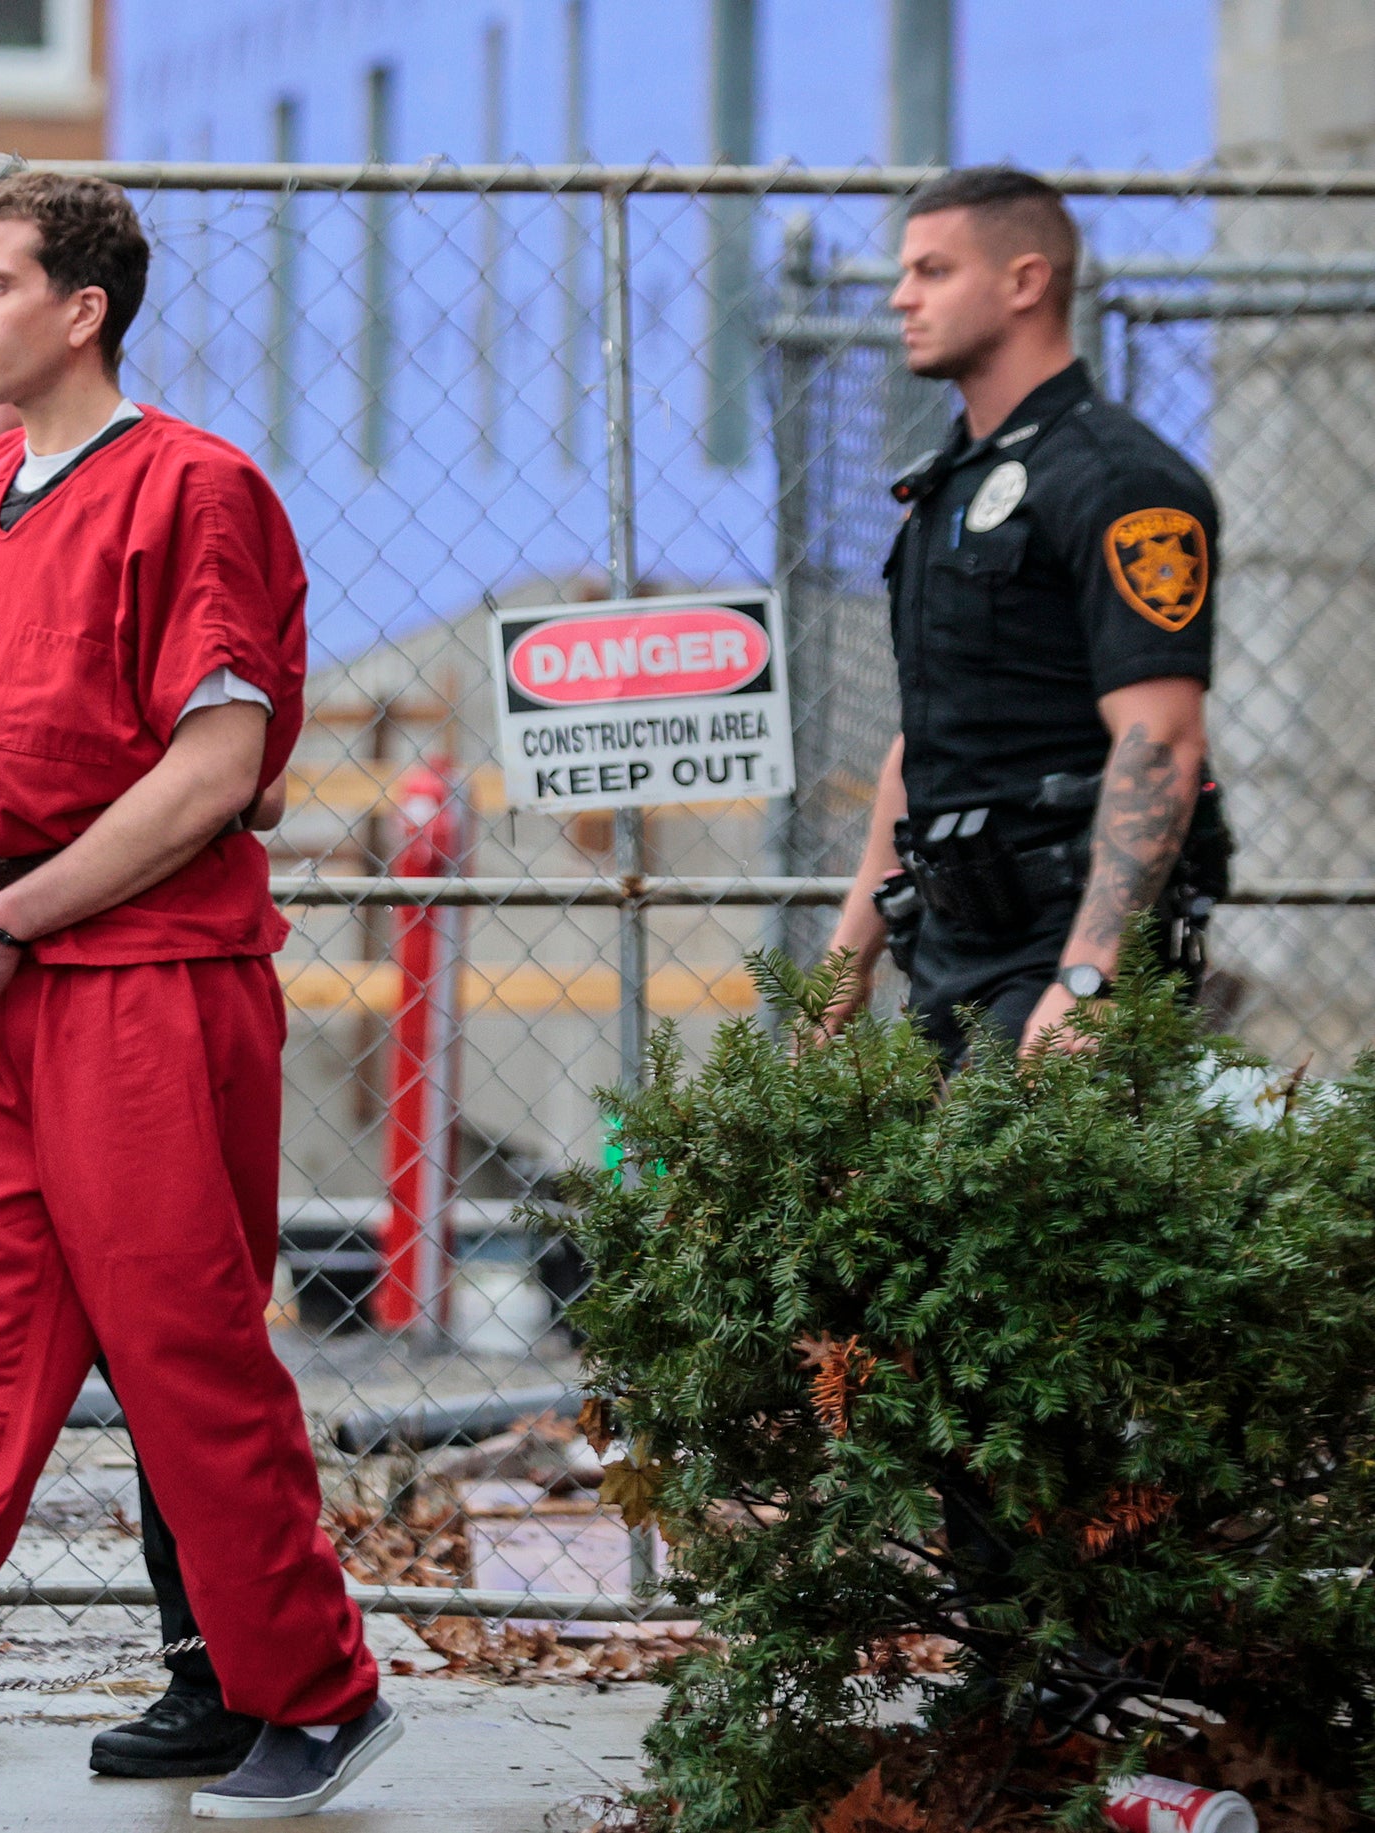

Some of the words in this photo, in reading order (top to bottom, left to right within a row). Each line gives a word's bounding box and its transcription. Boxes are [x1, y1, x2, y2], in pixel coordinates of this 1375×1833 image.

[529, 630, 748, 684] DANGER
[523, 714, 700, 757] CONSTRUCTION
[709, 710, 770, 742] AREA
[536, 762, 652, 798] KEEP
[672, 752, 761, 786] OUT
